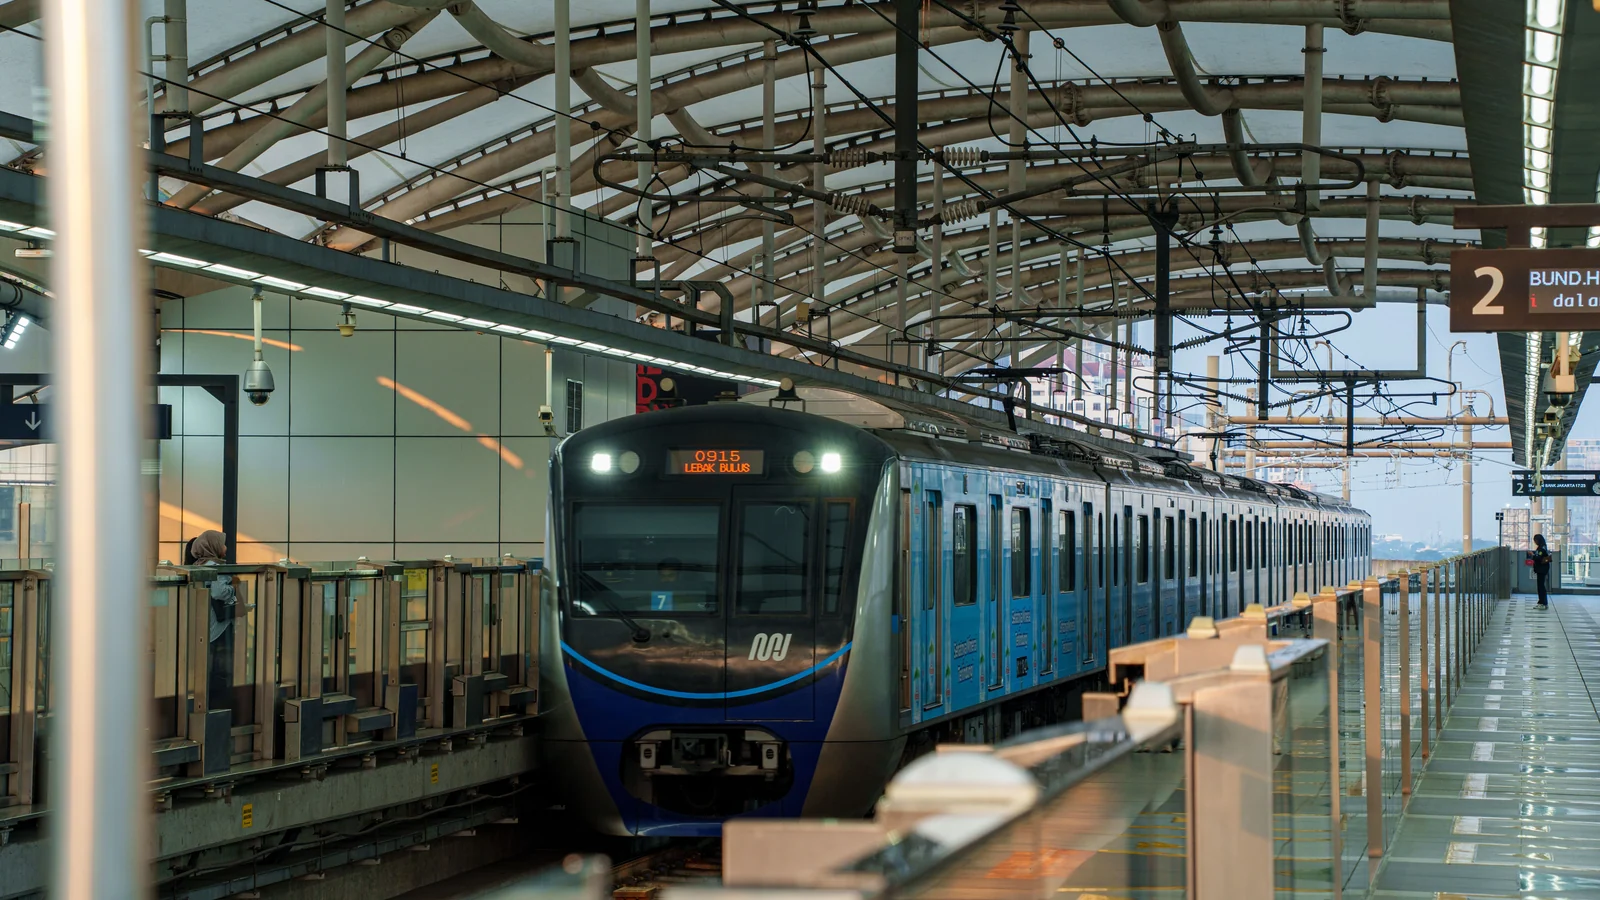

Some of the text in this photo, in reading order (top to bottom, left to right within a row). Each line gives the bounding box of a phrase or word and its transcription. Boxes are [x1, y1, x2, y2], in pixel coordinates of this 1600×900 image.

[1472, 266, 1504, 315] 2
[1553, 293, 1600, 308] dala
[695, 450, 741, 462] 0915
[684, 462, 751, 473] LEBAK BULUS
[1516, 482, 1524, 494] 2
[657, 595, 667, 609] 7
